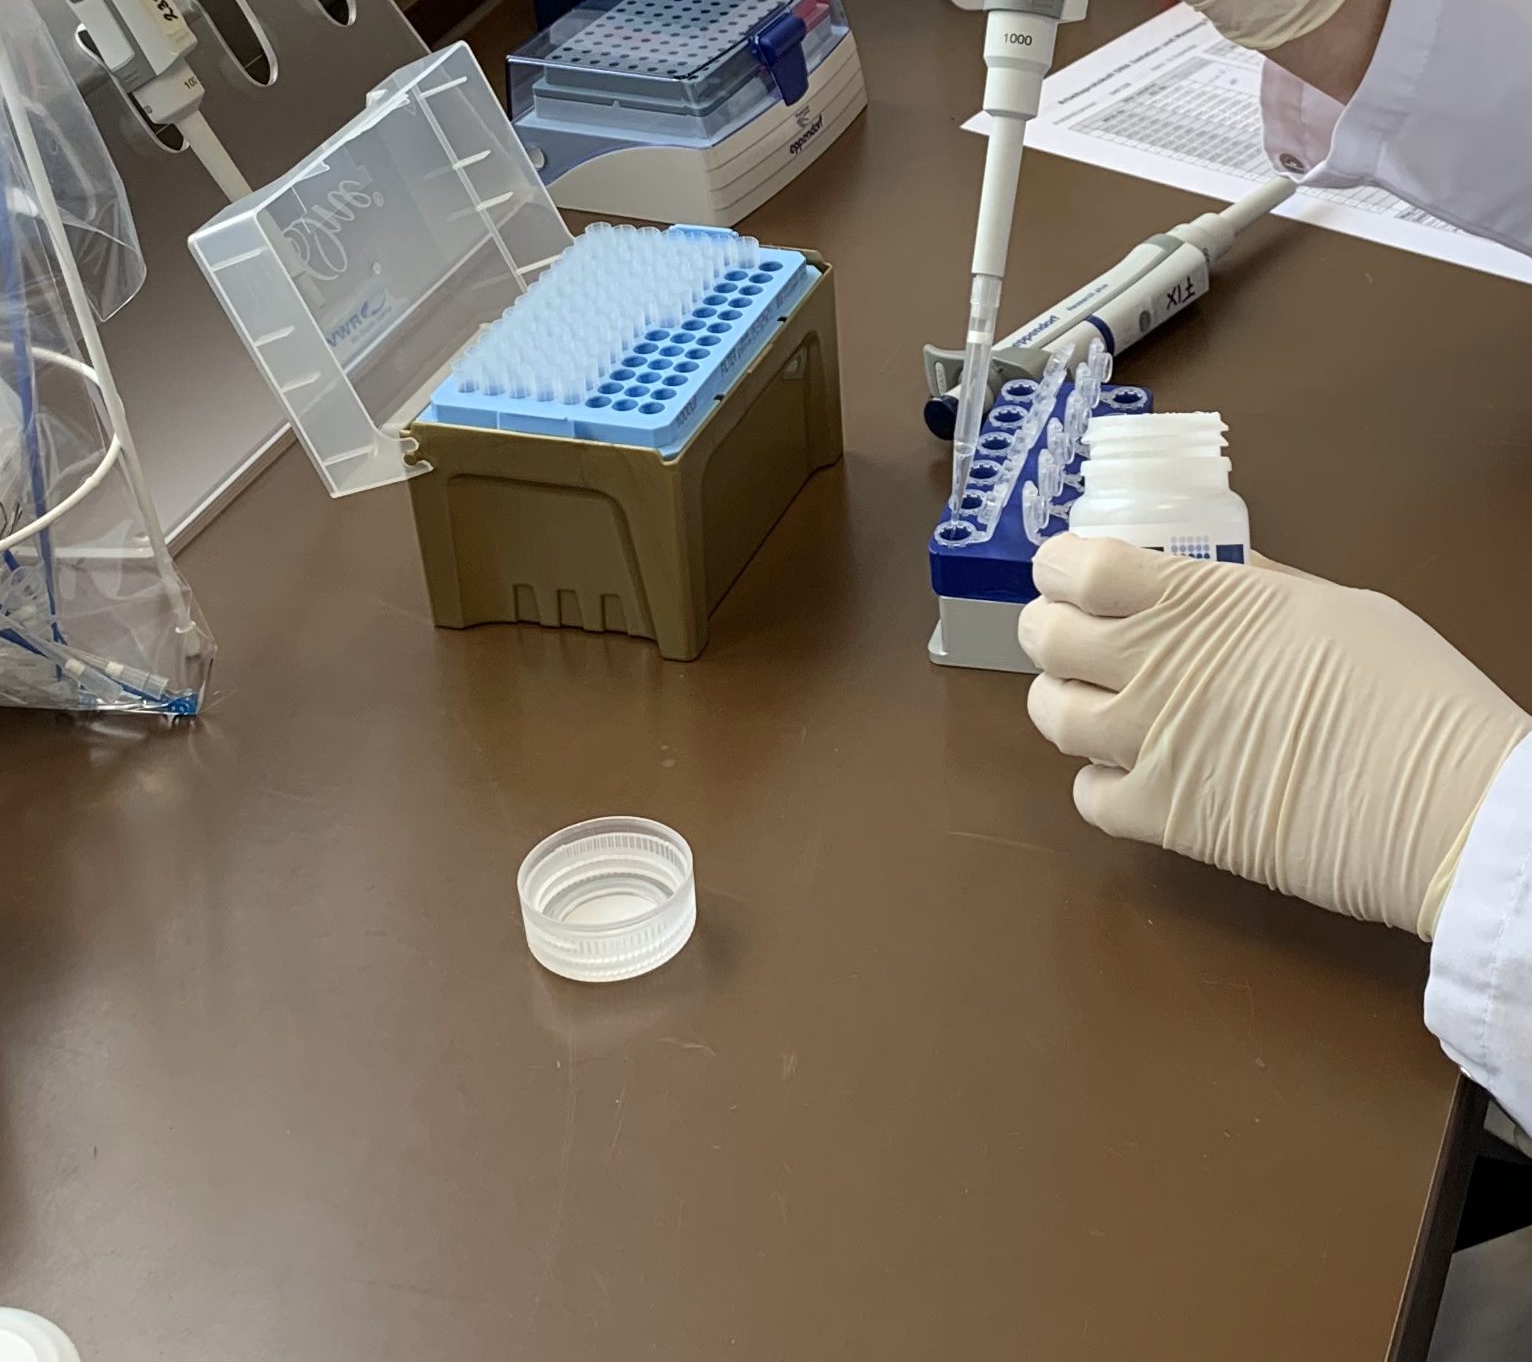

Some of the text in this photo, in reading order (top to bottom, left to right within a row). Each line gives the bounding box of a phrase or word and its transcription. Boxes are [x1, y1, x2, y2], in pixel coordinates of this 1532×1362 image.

[1003, 32, 1033, 47] 1000
[789, 113, 823, 155] eppendorf
[1166, 275, 1196, 310] FIX
[326, 314, 363, 348] VWR
